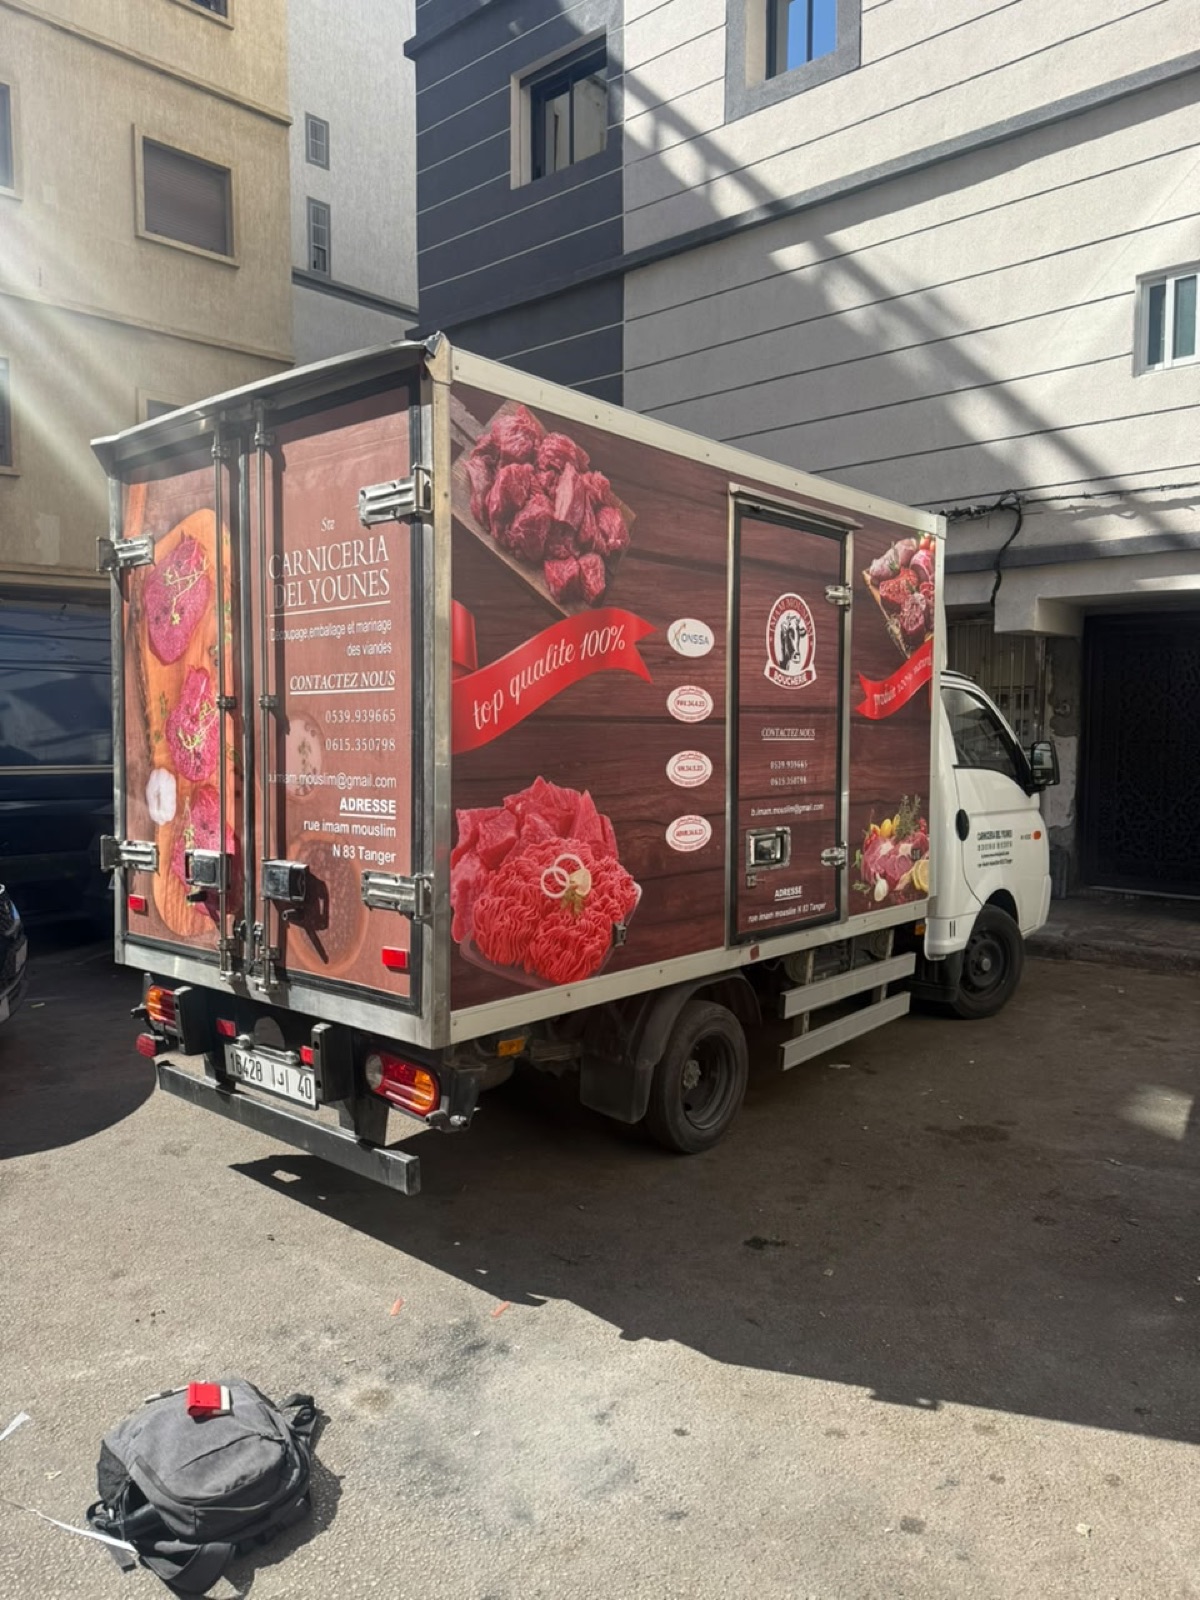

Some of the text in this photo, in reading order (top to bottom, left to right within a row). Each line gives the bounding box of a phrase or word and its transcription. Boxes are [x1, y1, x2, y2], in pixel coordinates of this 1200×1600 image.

[268, 535, 389, 580] CARNICERIA
[274, 568, 390, 609] DEL YOUNES
[347, 621, 355, 635] et
[680, 633, 710, 646] ONSSA
[346, 640, 392, 657] des viandes
[290, 670, 396, 691] CONTACTEZ NOUS
[473, 624, 626, 731] top qualite 100%
[773, 670, 807, 687] BOUCHERIE
[325, 708, 396, 724] 0539.939665
[761, 727, 798, 737] CONTACTEZ
[325, 738, 396, 751] 0615.350798
[340, 797, 396, 814] ADRESSE
[303, 820, 396, 838] rue imam mouslim
[332, 844, 396, 865] N 83 Tanger
[775, 885, 802, 897] ADRESSE
[230, 1052, 263, 1082] 16428
[298, 1074, 312, 1100] 40
